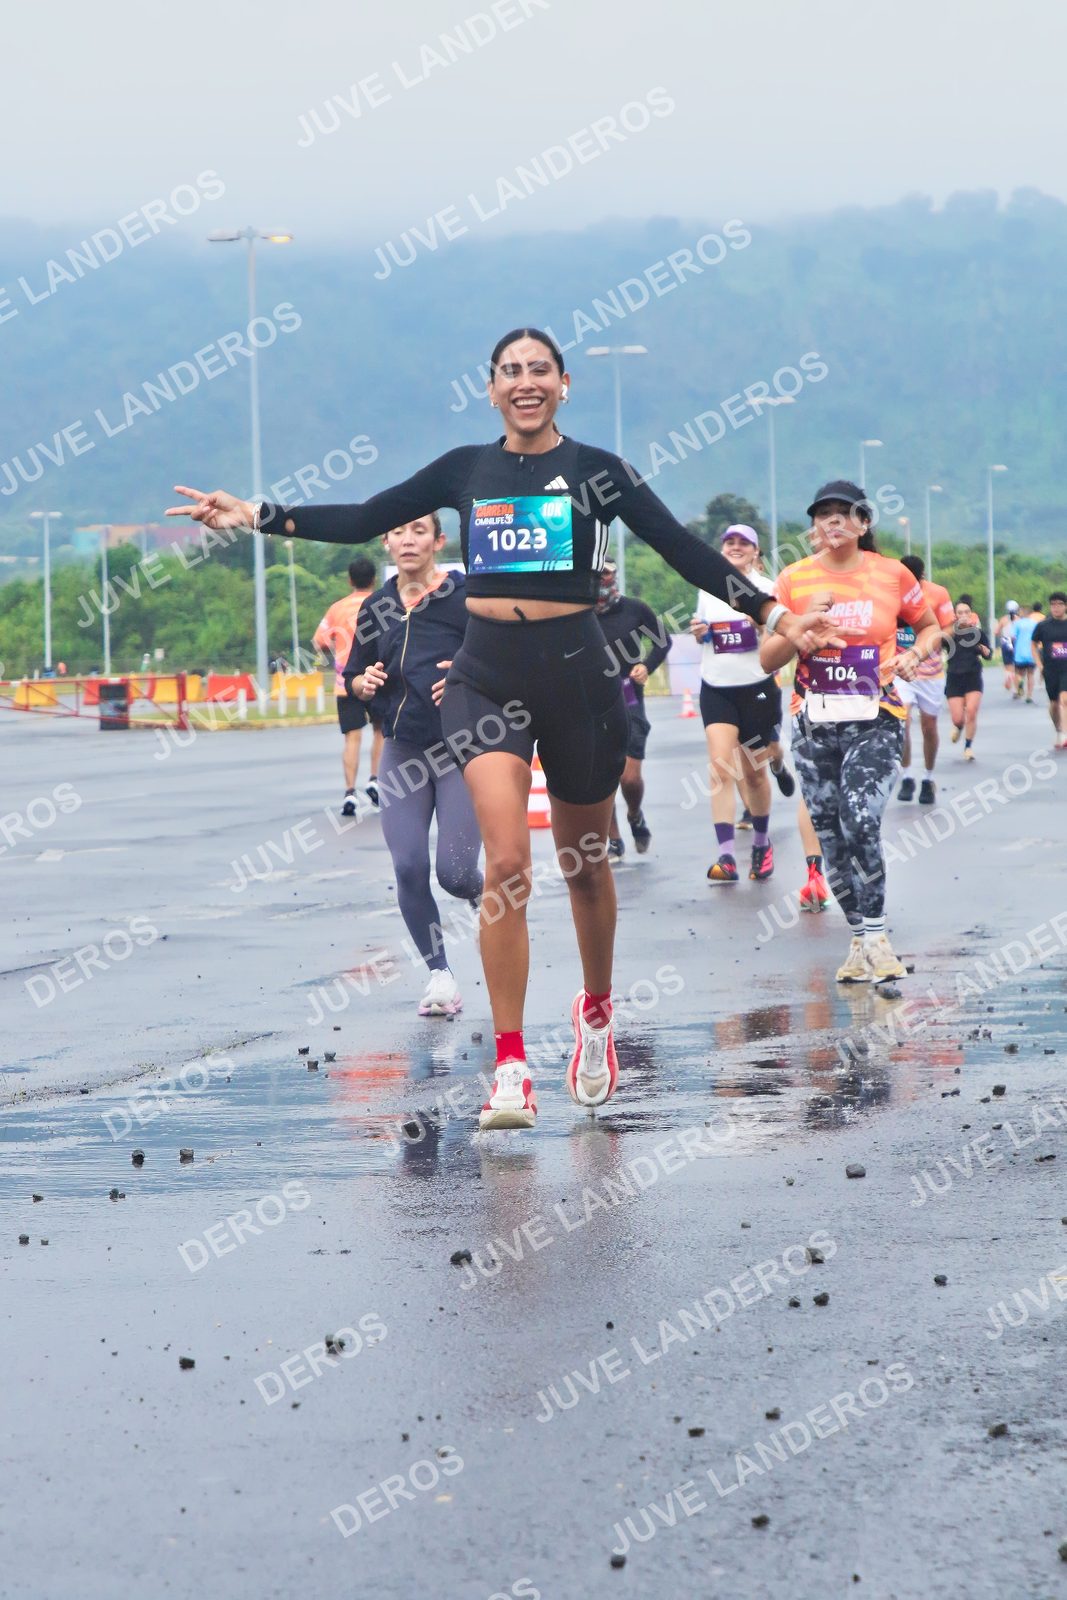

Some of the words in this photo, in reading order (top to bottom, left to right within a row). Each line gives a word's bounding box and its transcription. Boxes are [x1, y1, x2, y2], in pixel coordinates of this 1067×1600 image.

[541, 502, 563, 517] 10K
[488, 527, 547, 551] 1023
[721, 633, 742, 645] 733
[825, 666, 858, 682] 104
